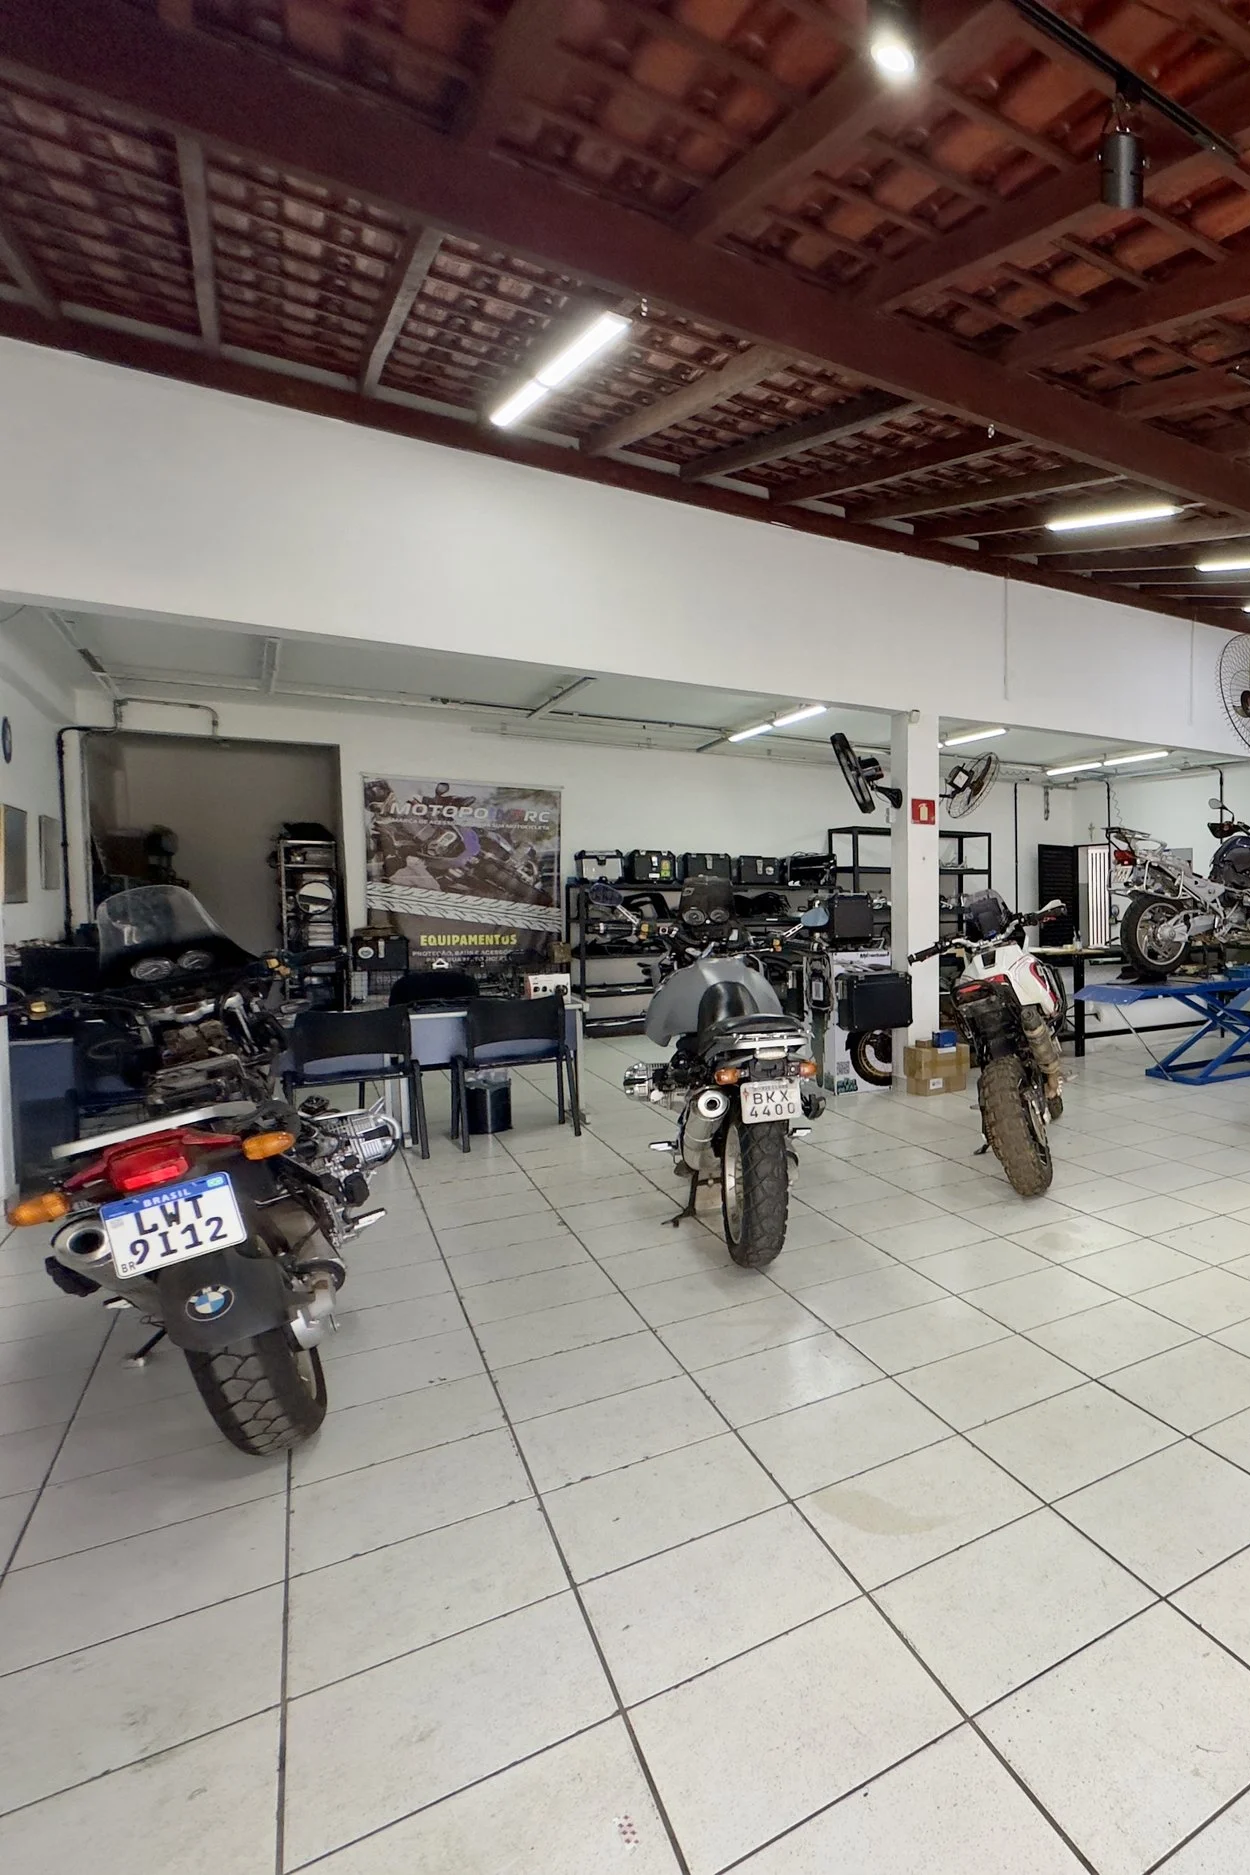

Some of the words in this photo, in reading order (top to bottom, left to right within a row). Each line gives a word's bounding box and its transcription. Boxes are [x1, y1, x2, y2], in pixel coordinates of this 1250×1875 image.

[420, 934, 517, 946] EQUIPAMENTOS
[753, 1090, 789, 1105] BKX
[750, 1102, 796, 1118] 4400
[143, 1189, 191, 1207] BRASIL
[134, 1195, 205, 1236] LWT
[130, 1215, 228, 1266] 9I12
[121, 1261, 136, 1274] BR
